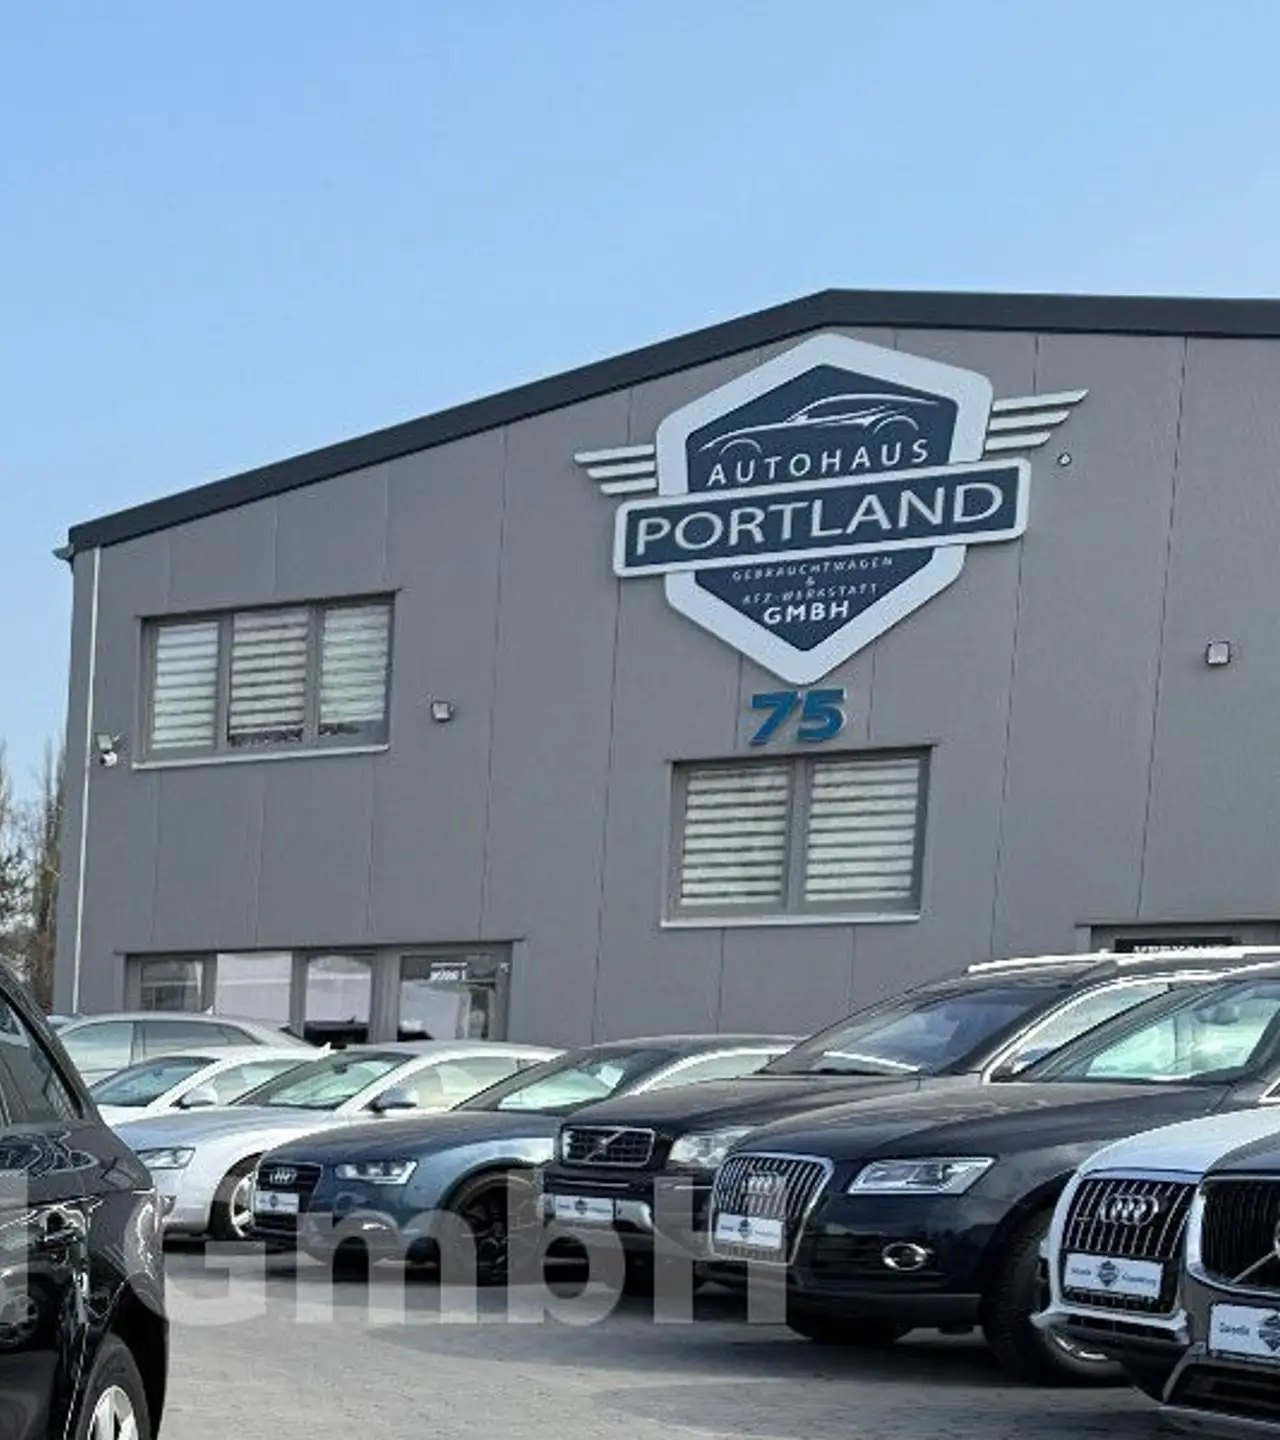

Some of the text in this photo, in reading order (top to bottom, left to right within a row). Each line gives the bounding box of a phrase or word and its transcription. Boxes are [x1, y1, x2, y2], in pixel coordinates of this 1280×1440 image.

[706, 438, 929, 487] AUTOHAUS
[635, 481, 1004, 556] PORTLAND
[763, 600, 849, 625] GMBH
[748, 688, 845, 746] 75
